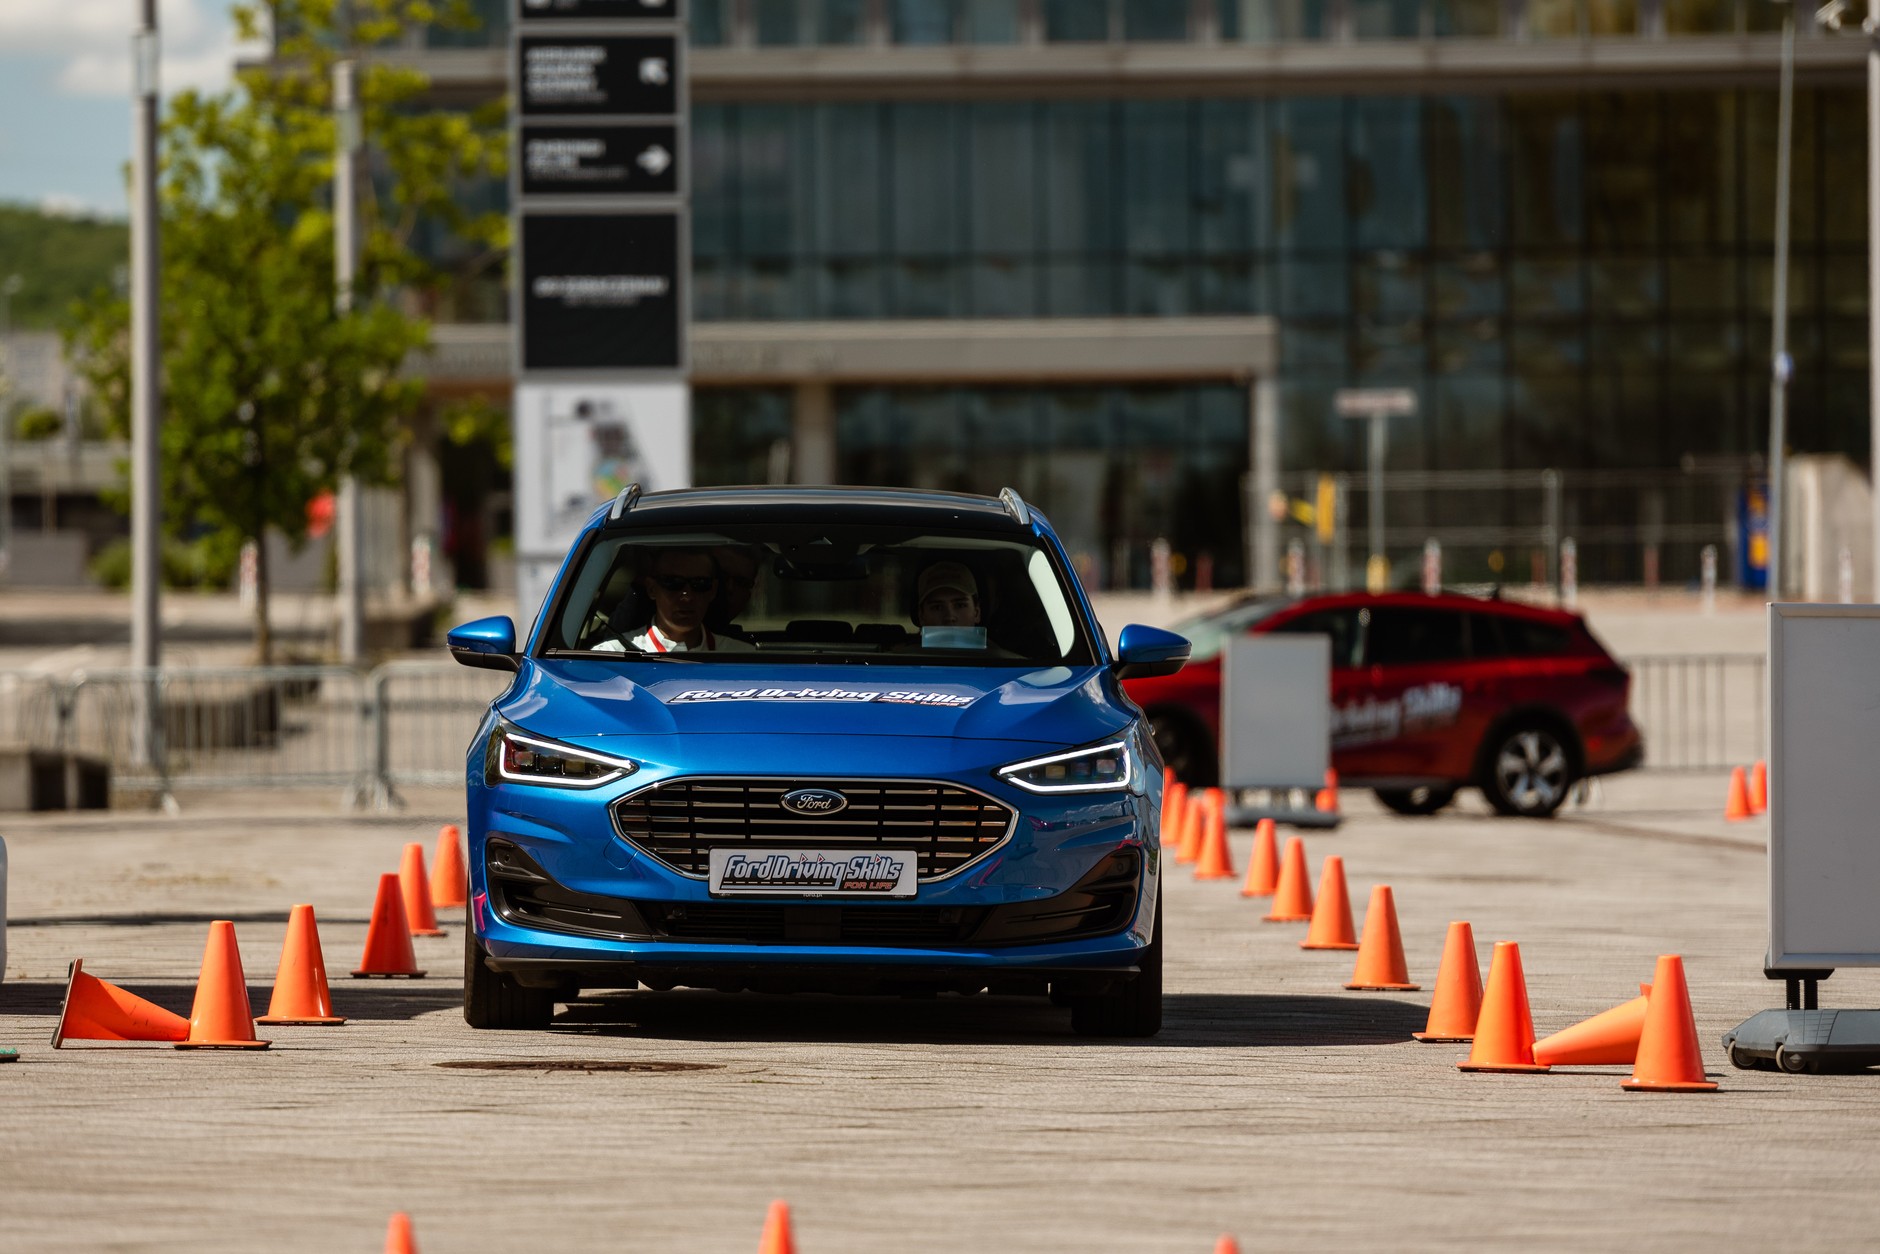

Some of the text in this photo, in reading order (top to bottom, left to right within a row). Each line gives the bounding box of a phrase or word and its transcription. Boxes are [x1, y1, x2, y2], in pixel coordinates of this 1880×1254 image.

[676, 688, 975, 703] Ford Driving Skills
[1402, 682, 1462, 718] Skills
[797, 794, 831, 809] Ford
[724, 854, 903, 889] Ford Driving Skills
[844, 881, 892, 889] FOR LIFE
